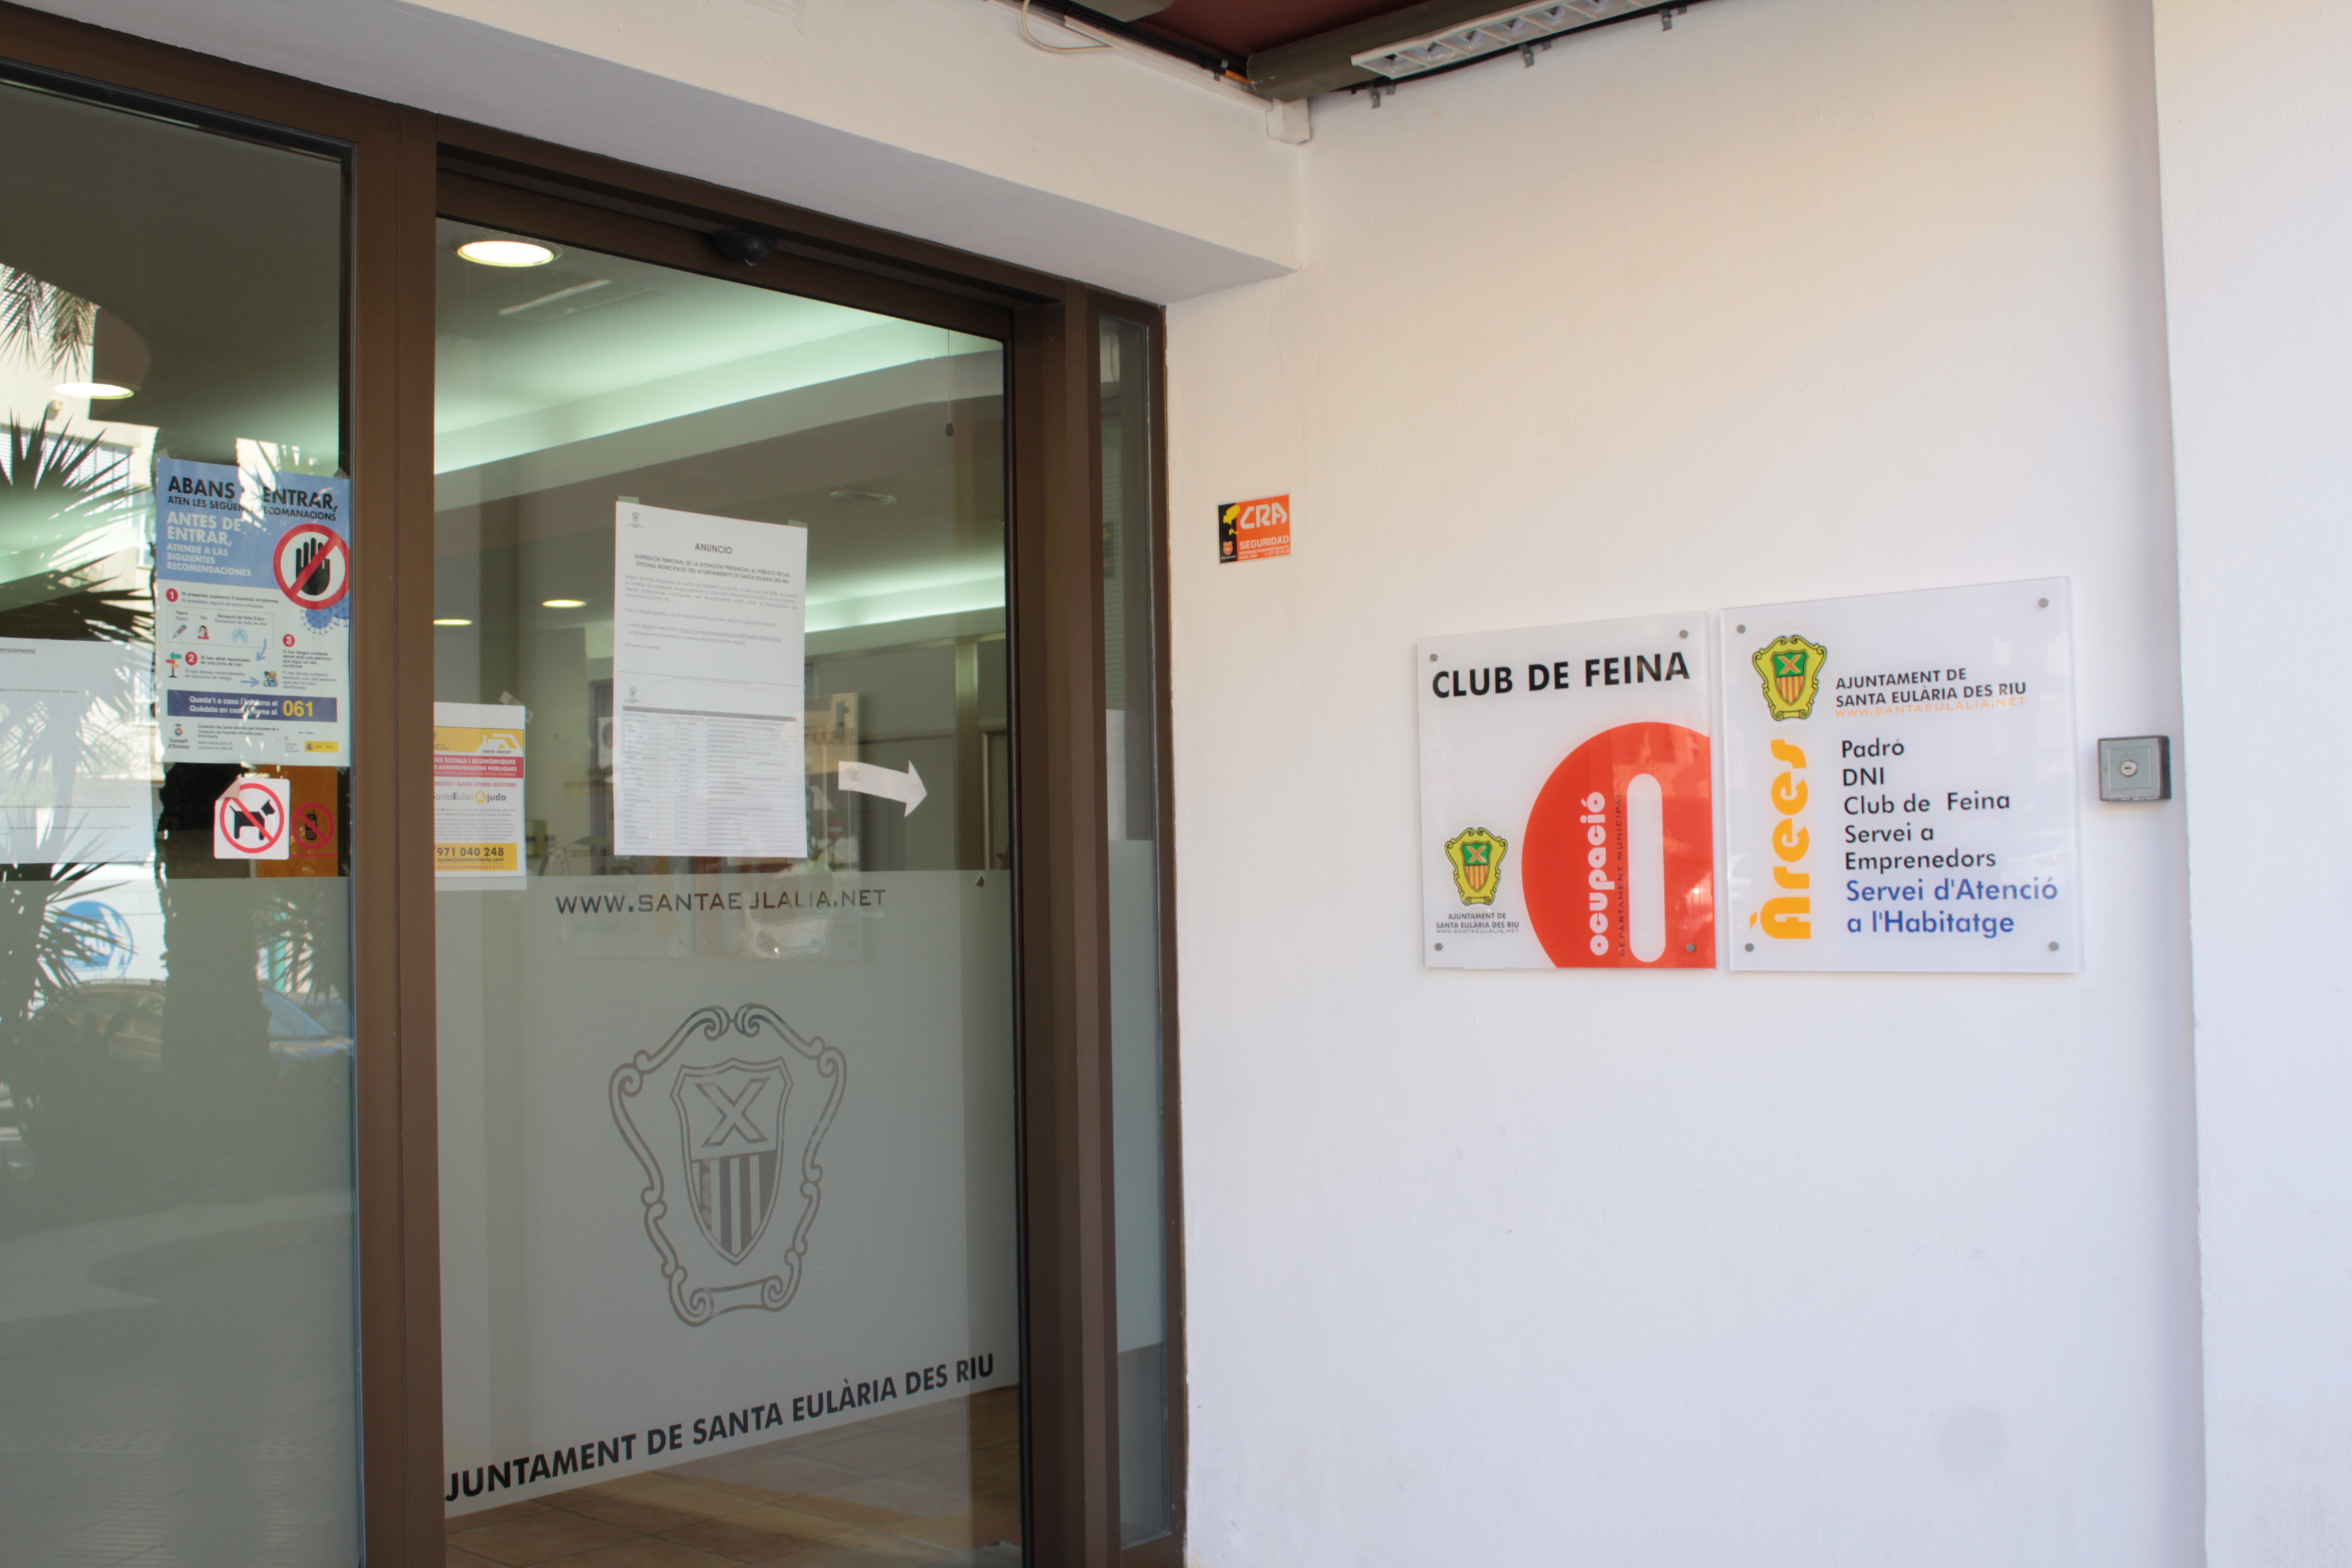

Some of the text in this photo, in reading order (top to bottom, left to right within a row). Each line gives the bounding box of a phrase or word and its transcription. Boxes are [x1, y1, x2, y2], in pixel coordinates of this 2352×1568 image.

[168, 476, 235, 499] ABANS
[168, 495, 189, 506] ATÉN
[193, 499, 207, 508] LES
[261, 506, 336, 521] ECOMANACIONS
[1240, 502, 1288, 529] CRA
[167, 511, 242, 532] ANTES DE
[167, 526, 232, 547] ENTRAR,
[1240, 536, 1289, 550] SEGURIDAD
[167, 543, 201, 553] ATIENDE
[213, 548, 228, 556] LAS
[167, 553, 215, 564] SIGUIENTES
[634, 553, 660, 561] SUSPENSIÓN
[695, 543, 732, 554] ANUNCIO
[167, 561, 251, 576] RECOMENDACIONES
[697, 569, 732, 577] AYUNTAMIENTO
[1432, 651, 1690, 698] CLUB DE FEINA
[1836, 668, 1966, 689] AJUNTAMENT DE
[1836, 682, 2026, 708] SANTA EULÀRIA DES RIU
[283, 700, 312, 717] 061
[1835, 697, 2026, 717] WWW.SANTAEULALIA.NET
[1842, 737, 1906, 757] Padró
[1843, 767, 1884, 786] DNI
[1844, 790, 2010, 815] Club de Feina
[1845, 823, 1934, 843] Servei a
[438, 847, 504, 856] 971 040 248
[1845, 848, 1996, 874] Emprenedors
[1580, 792, 1615, 956] ocupació
[1847, 877, 2057, 901] Servei d'Atenció
[1617, 866, 1625, 956] DEPARTAMENT
[1461, 920, 1489, 928] EULÀRIA
[1848, 911, 2014, 938] a l'Habitatge
[444, 1353, 994, 1502] JUNTAMENT DE SANTA EULÀRIA DES RIU
